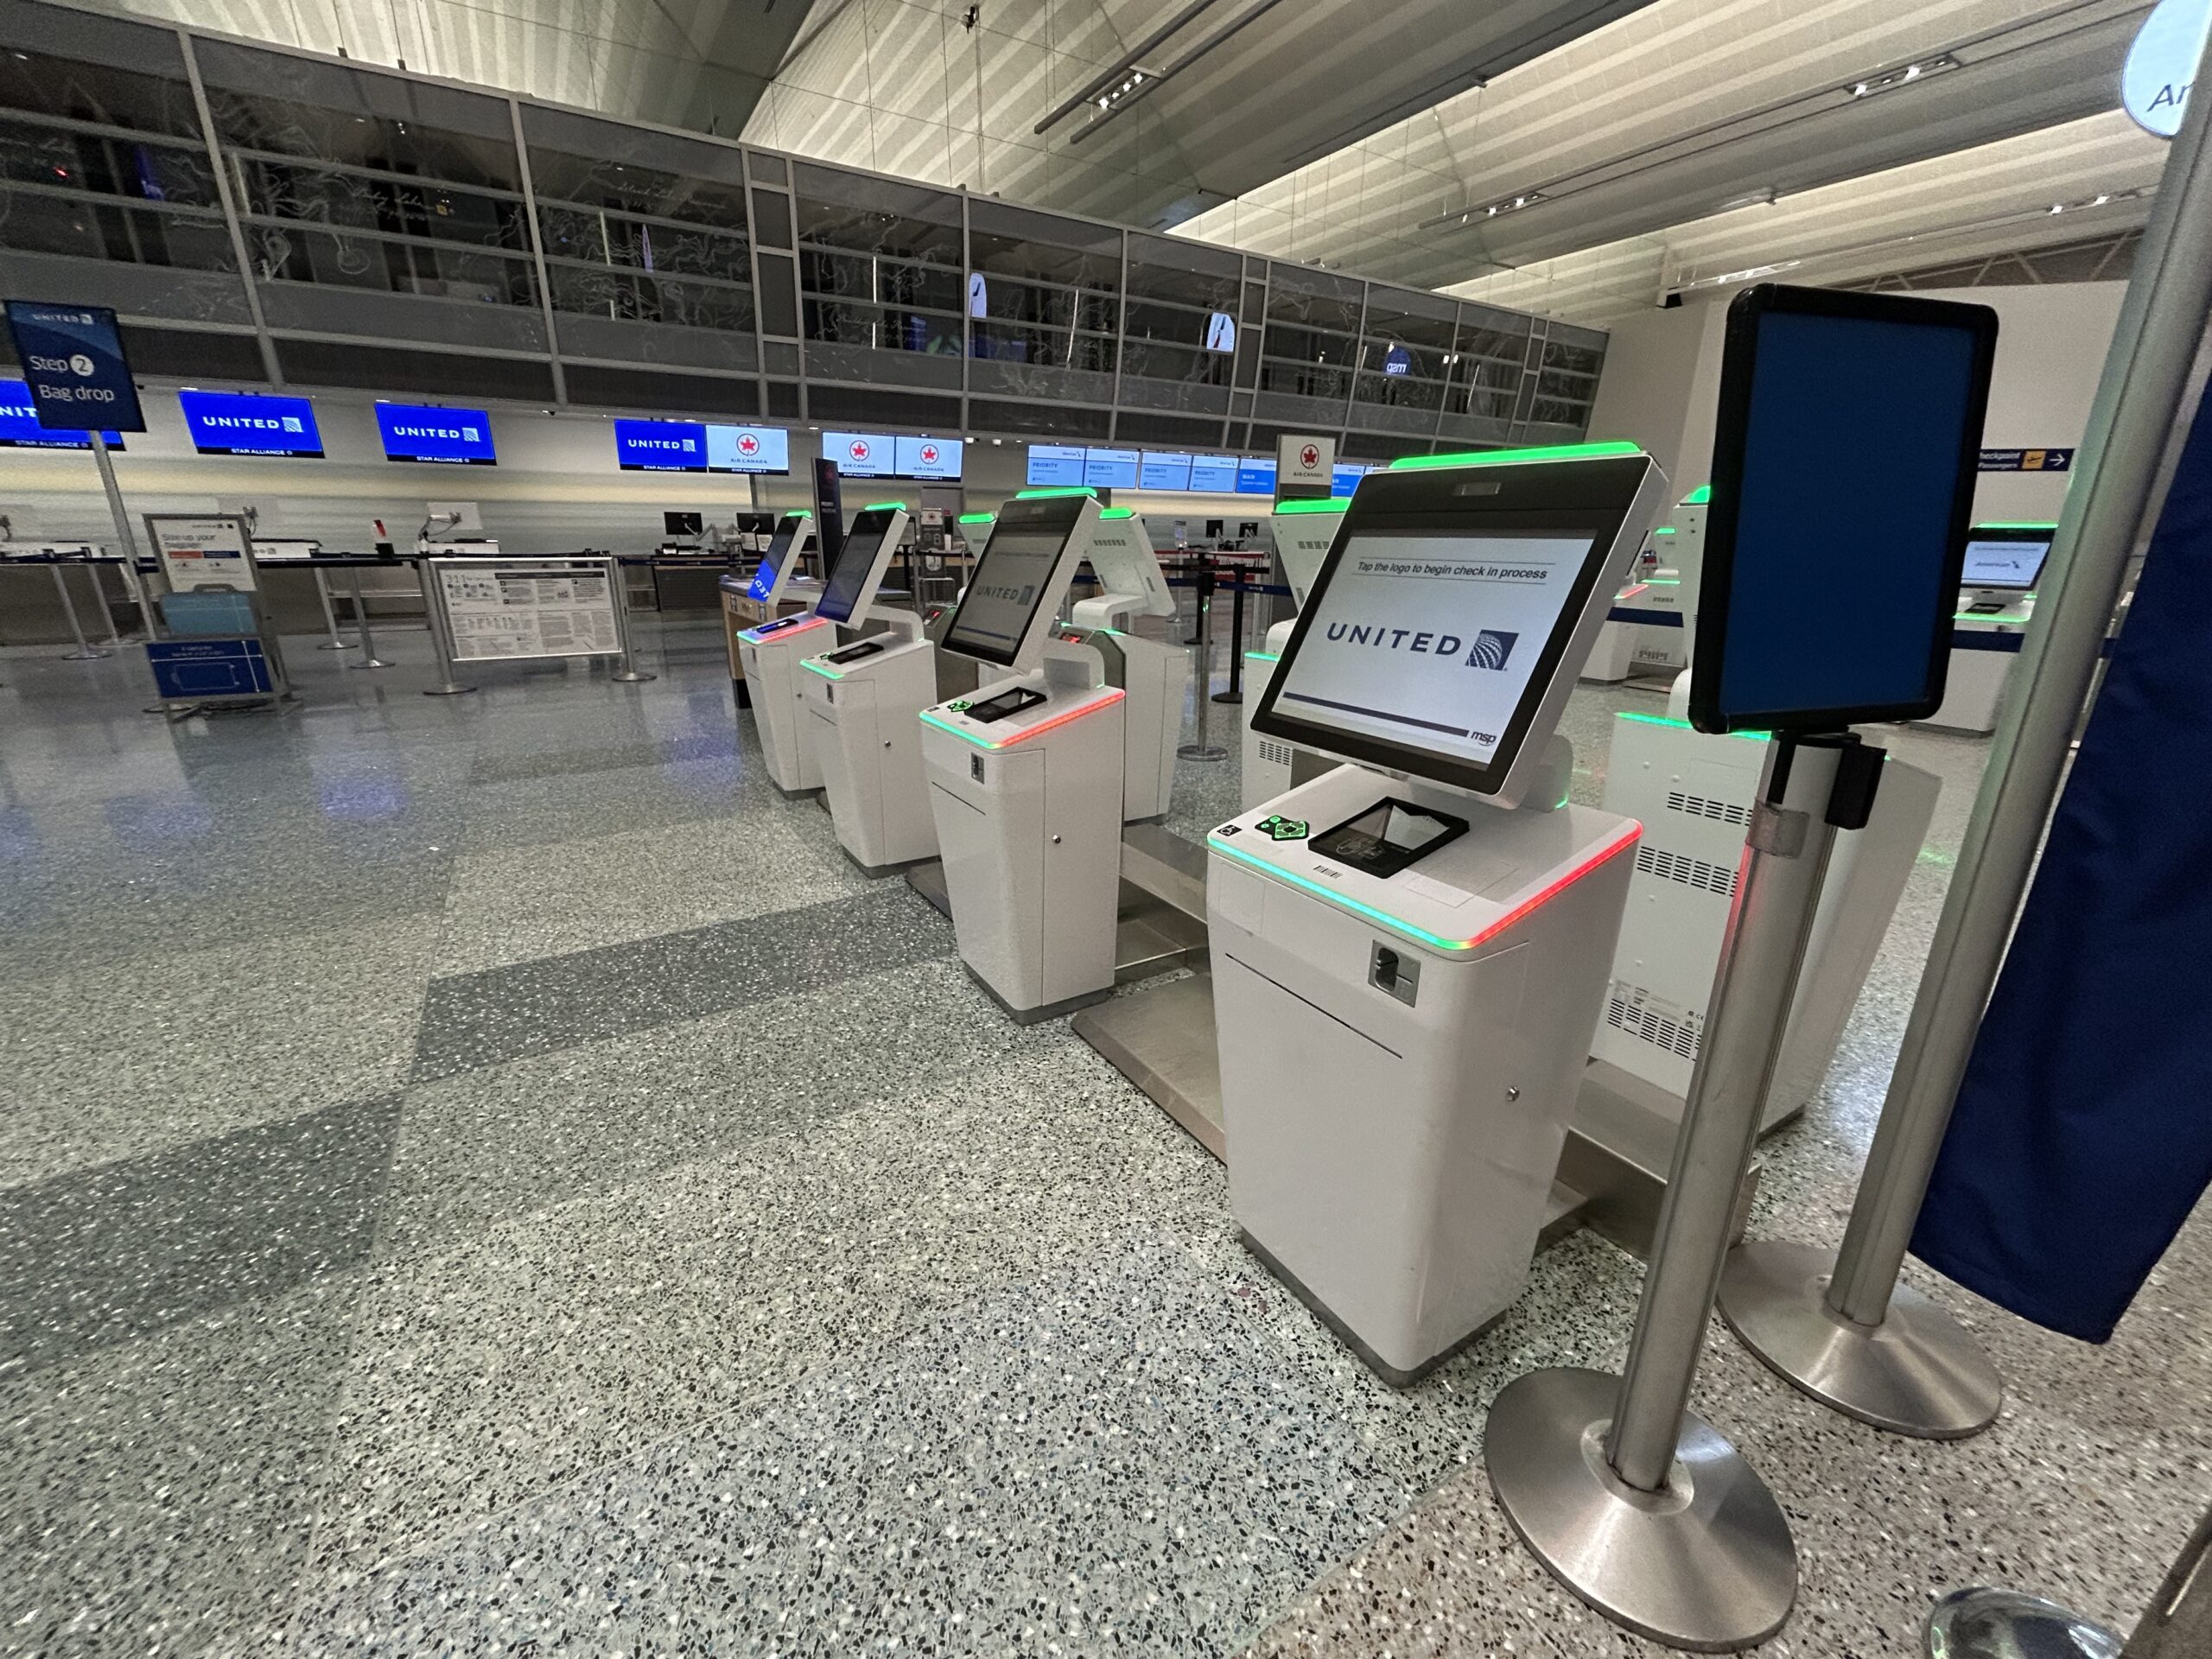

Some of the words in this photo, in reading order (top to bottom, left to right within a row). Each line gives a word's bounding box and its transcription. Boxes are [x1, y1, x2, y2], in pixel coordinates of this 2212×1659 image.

[29, 356, 68, 373] Step
[38, 385, 74, 402] Bag
[75, 386, 115, 403] drop
[202, 416, 279, 429] UNITED
[394, 426, 460, 438] UNITED
[627, 439, 680, 449] UNITED
[1358, 562, 1373, 572] Tap
[1374, 563, 1389, 571] the
[1390, 563, 1411, 575] logo
[1412, 564, 1422, 573] to
[1424, 564, 1452, 575] begin
[1453, 566, 1485, 576] check
[1487, 567, 1498, 576] in
[1498, 569, 1548, 579] process
[976, 585, 1020, 601] UNITED
[1327, 622, 1461, 656] UNITED
[1471, 731, 1497, 744] msp
